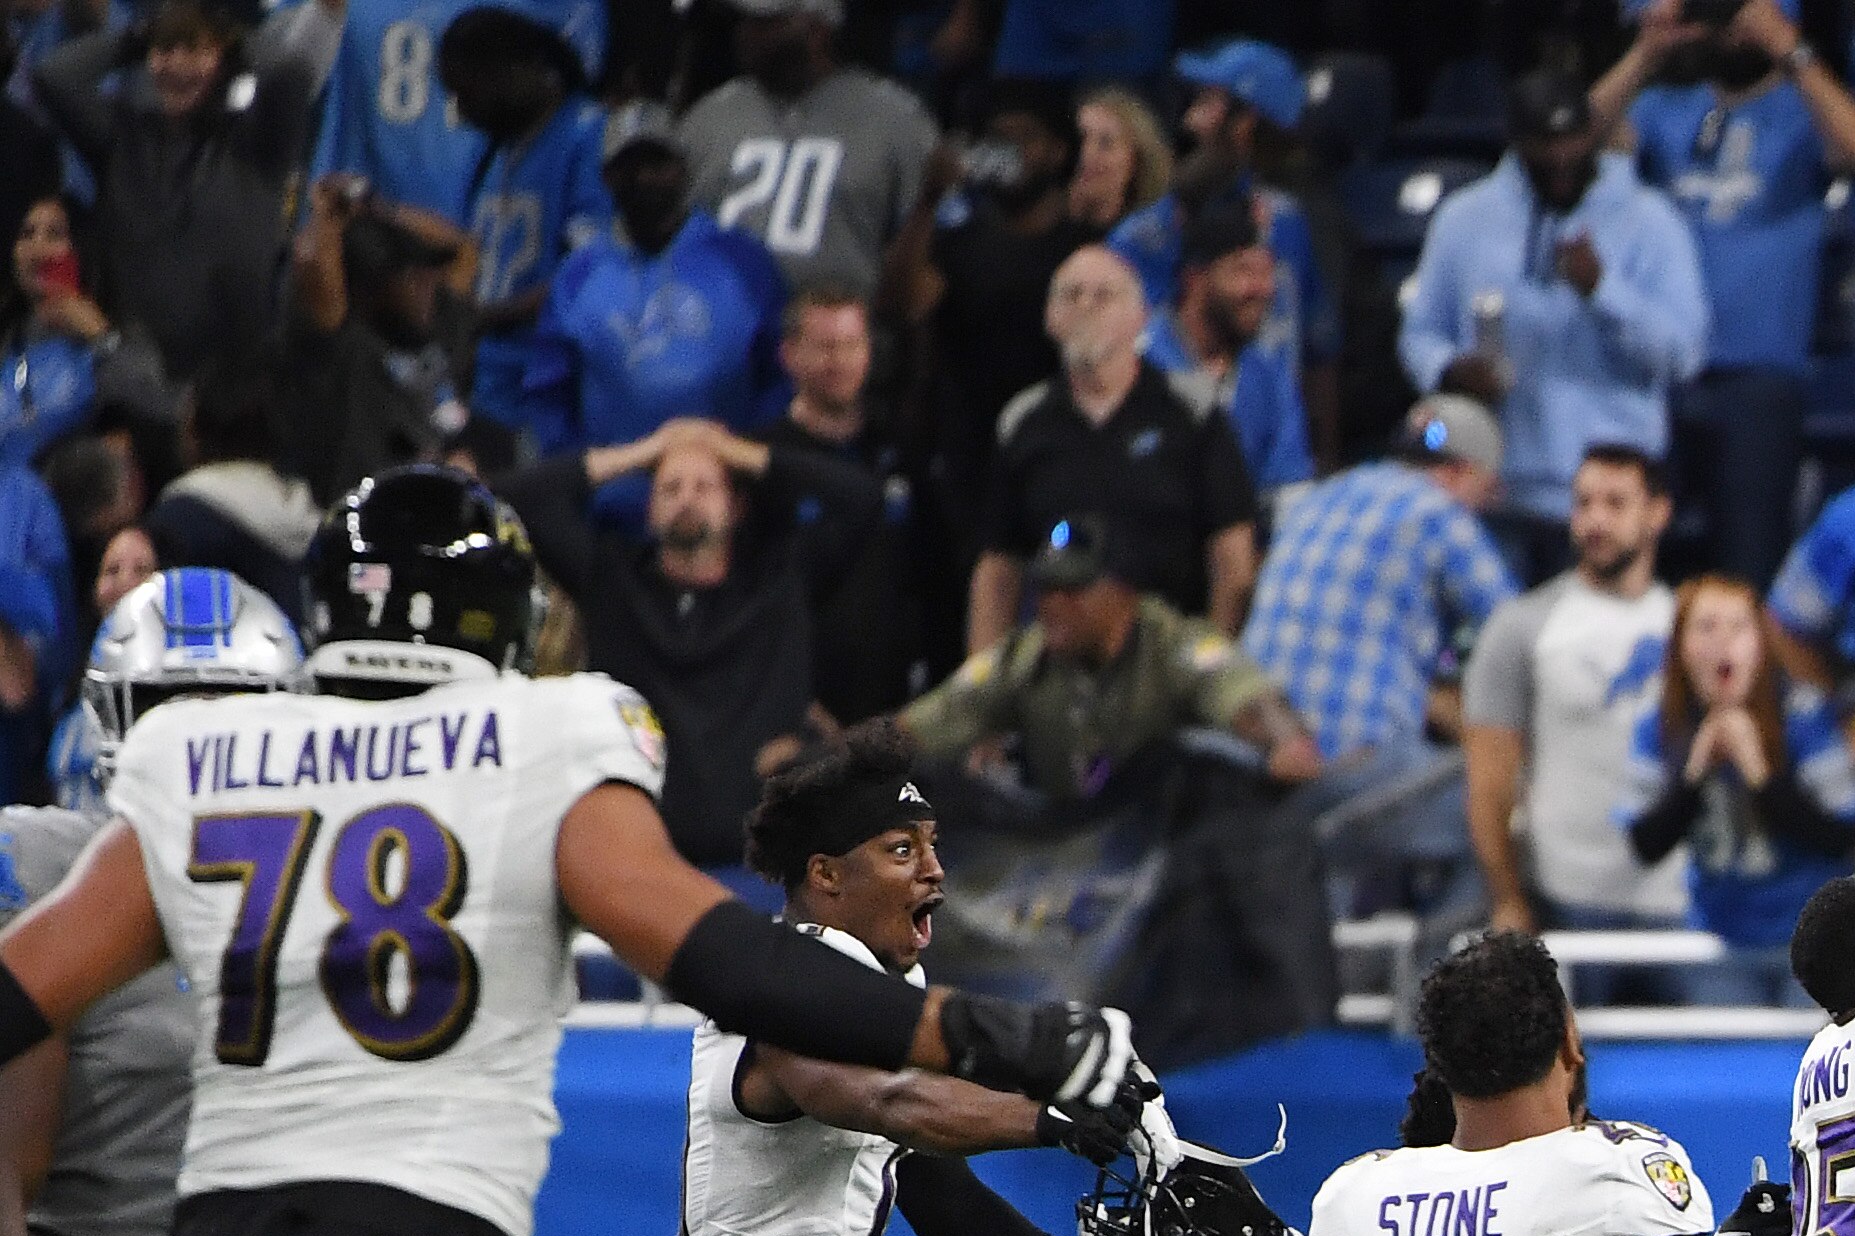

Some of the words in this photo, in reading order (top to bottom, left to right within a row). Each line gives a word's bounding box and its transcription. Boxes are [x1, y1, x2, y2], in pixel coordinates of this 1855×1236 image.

[718, 137, 845, 254] 20
[186, 710, 503, 796] VILLANUEVA
[186, 801, 481, 1067] 78
